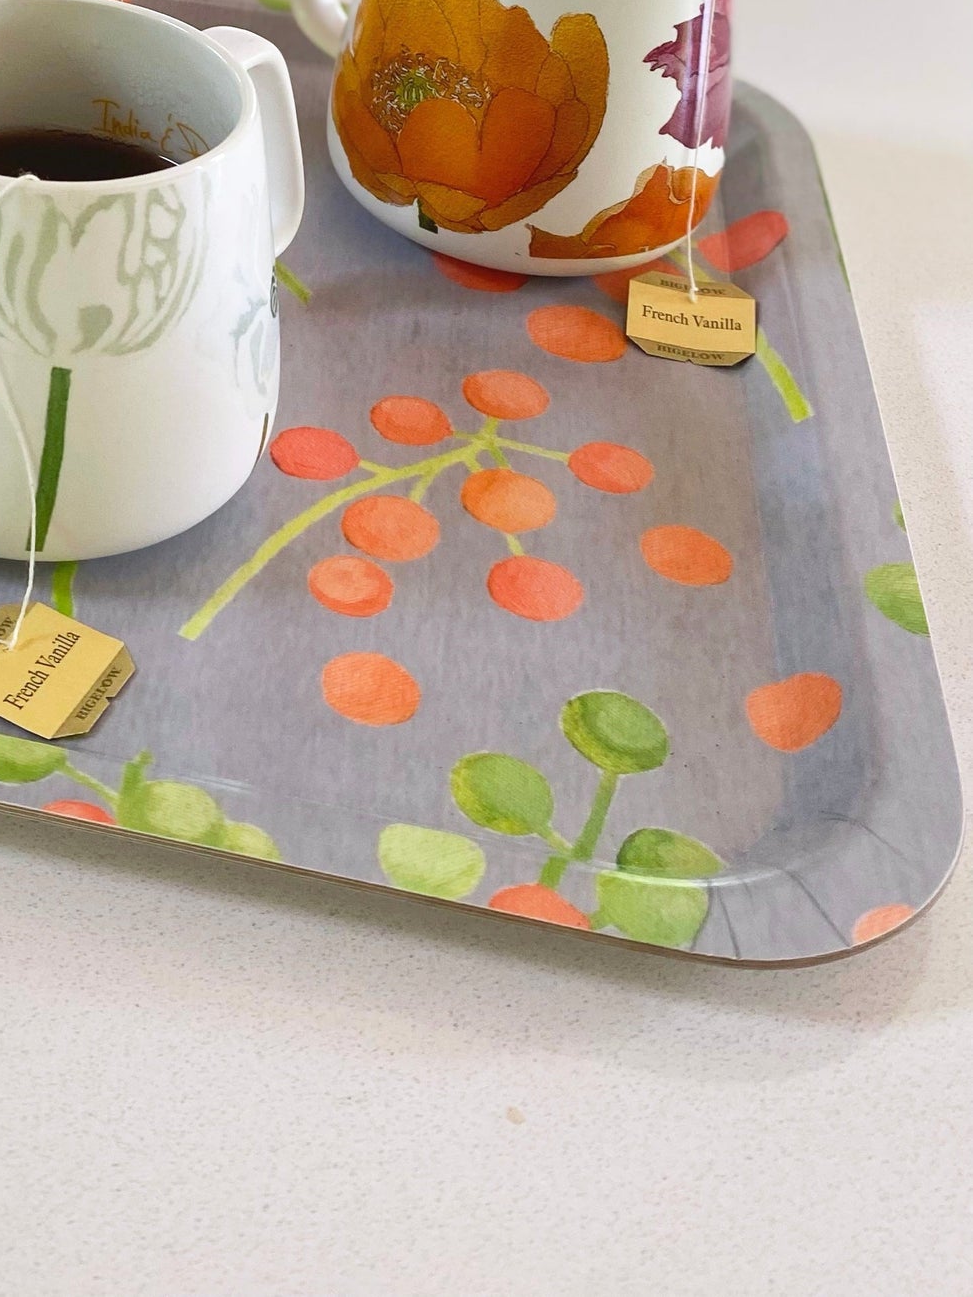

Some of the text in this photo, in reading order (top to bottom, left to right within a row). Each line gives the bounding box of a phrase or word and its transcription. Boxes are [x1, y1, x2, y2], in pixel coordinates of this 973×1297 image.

[91, 98, 157, 142] India
[660, 279, 726, 295] BIGEOW
[642, 304, 742, 331] French Vanilla
[657, 343, 725, 360] BIGELOW
[3, 631, 81, 710] French Vanilla
[76, 667, 122, 721] BIGELOW
